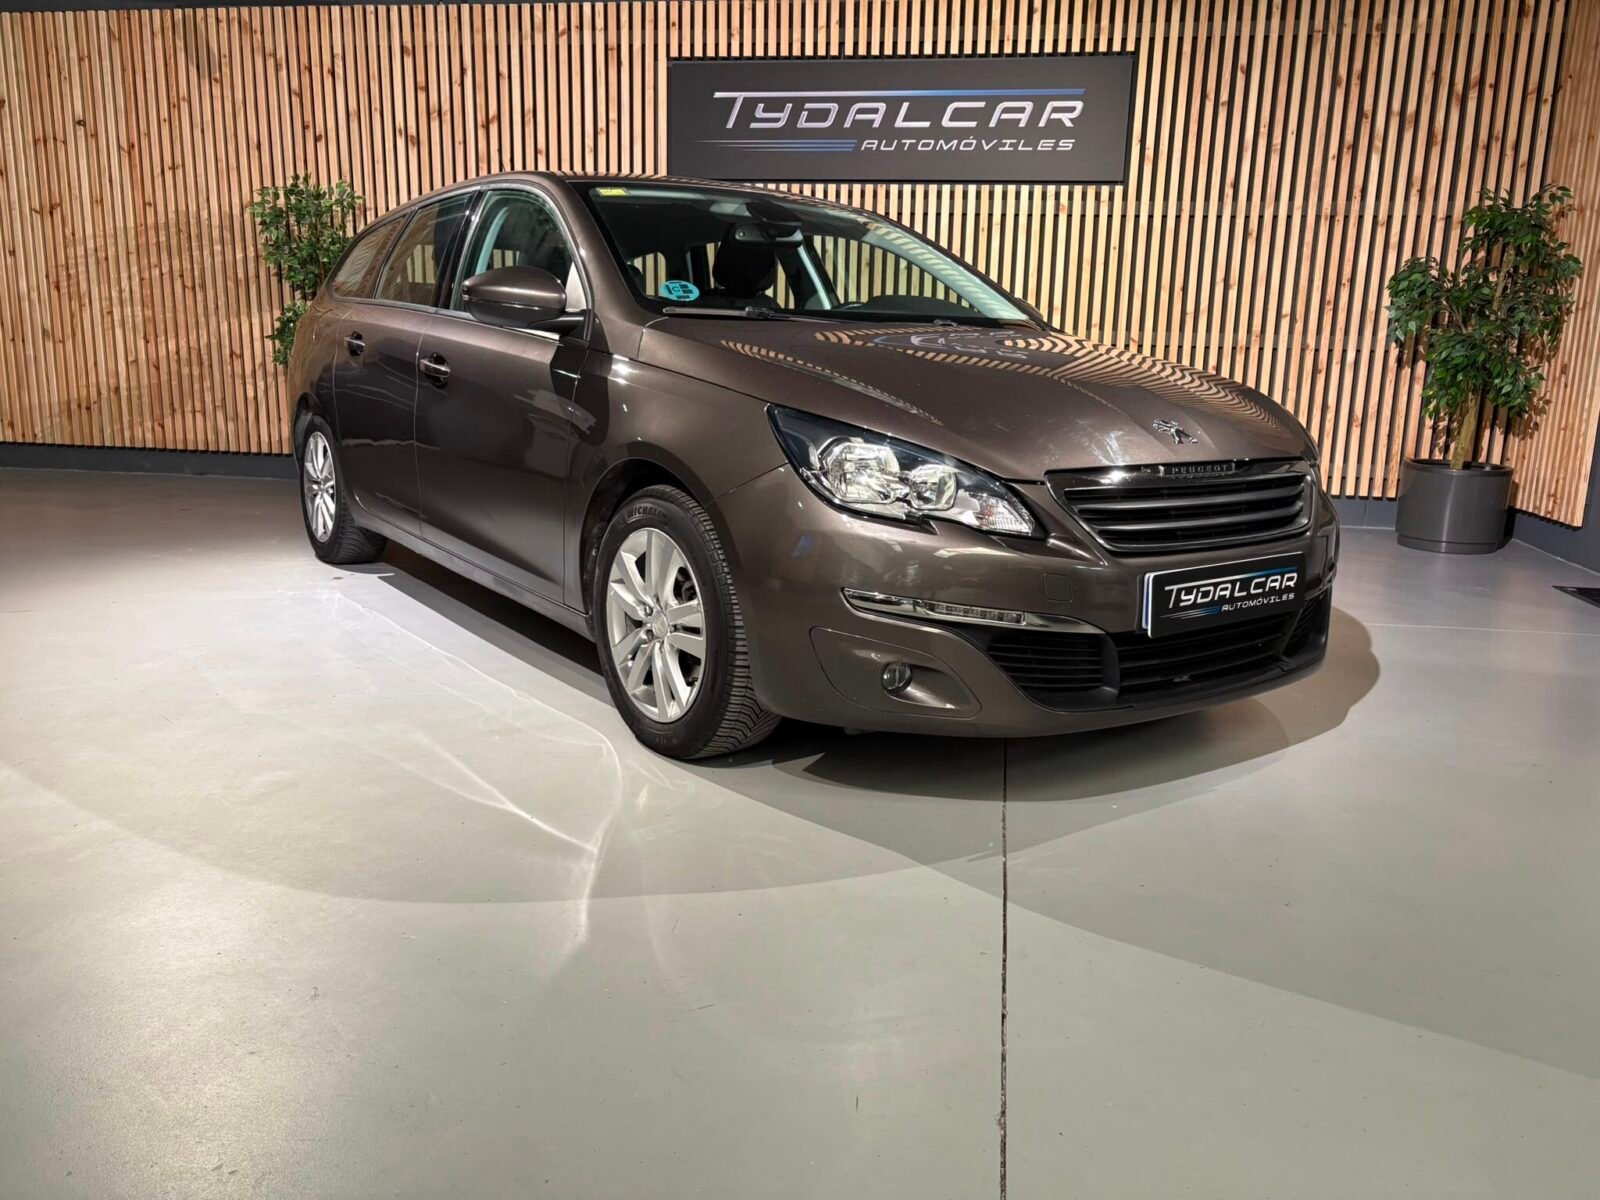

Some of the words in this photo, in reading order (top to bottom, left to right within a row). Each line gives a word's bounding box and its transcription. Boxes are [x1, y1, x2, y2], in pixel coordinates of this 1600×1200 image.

[713, 89, 1085, 129] TYDALCAR
[860, 137, 1076, 152] AUTOMÓVILES
[1171, 464, 1228, 474] PEUGEOT
[1164, 567, 1298, 609] TYDALCAR
[1221, 592, 1296, 612] AUTOMÓVILES
